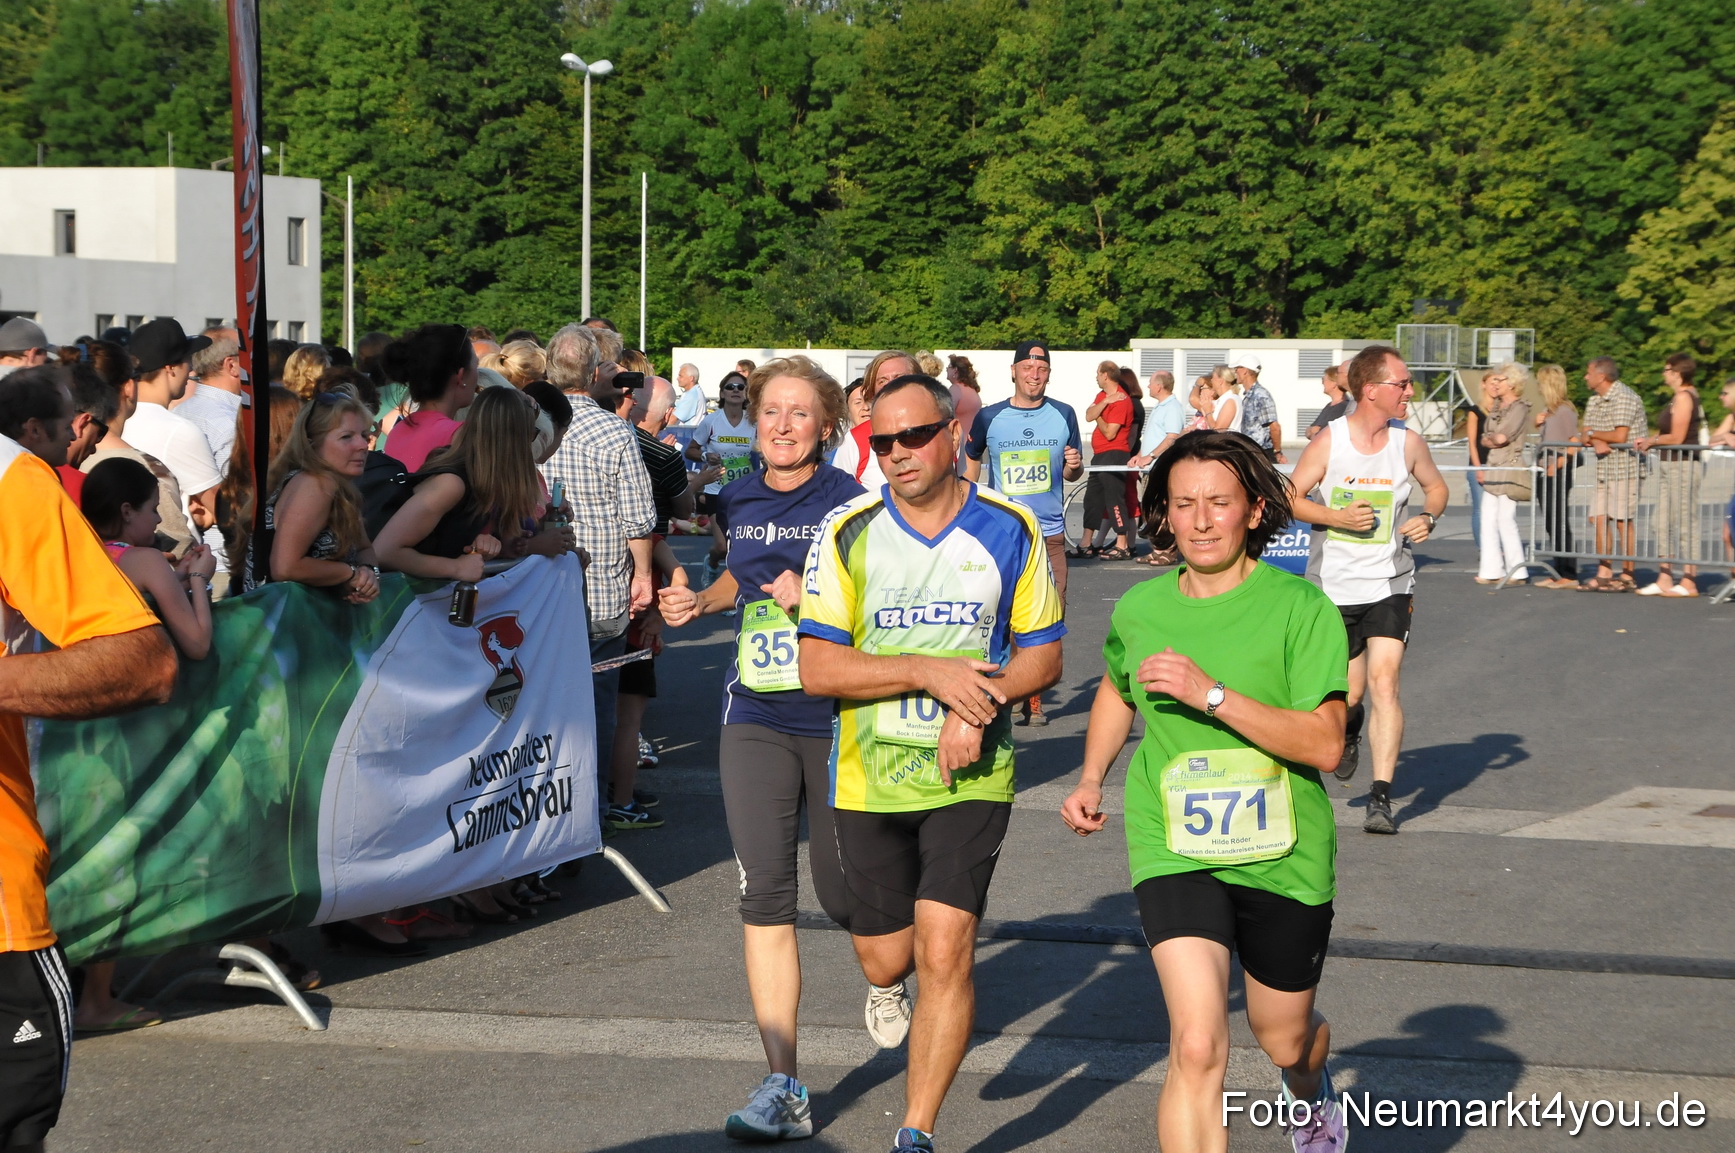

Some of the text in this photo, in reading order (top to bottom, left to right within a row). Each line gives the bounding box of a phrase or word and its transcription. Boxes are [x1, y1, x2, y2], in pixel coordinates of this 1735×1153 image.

[998, 439, 1059, 449] SCHABMÜLLER
[1003, 464, 1048, 485] 1248
[874, 601, 984, 630] BOCK
[751, 631, 799, 669] 35
[900, 689, 950, 722] 10
[906, 723, 930, 731] Manfred
[1181, 768, 1226, 779] firmenlauf
[446, 768, 572, 854] Lammsbräu
[1184, 788, 1267, 836] 571
[1217, 845, 1255, 855] Landkreises
[1256, 841, 1286, 851] Neumarkt
[13, 1031, 42, 1043] adidas
